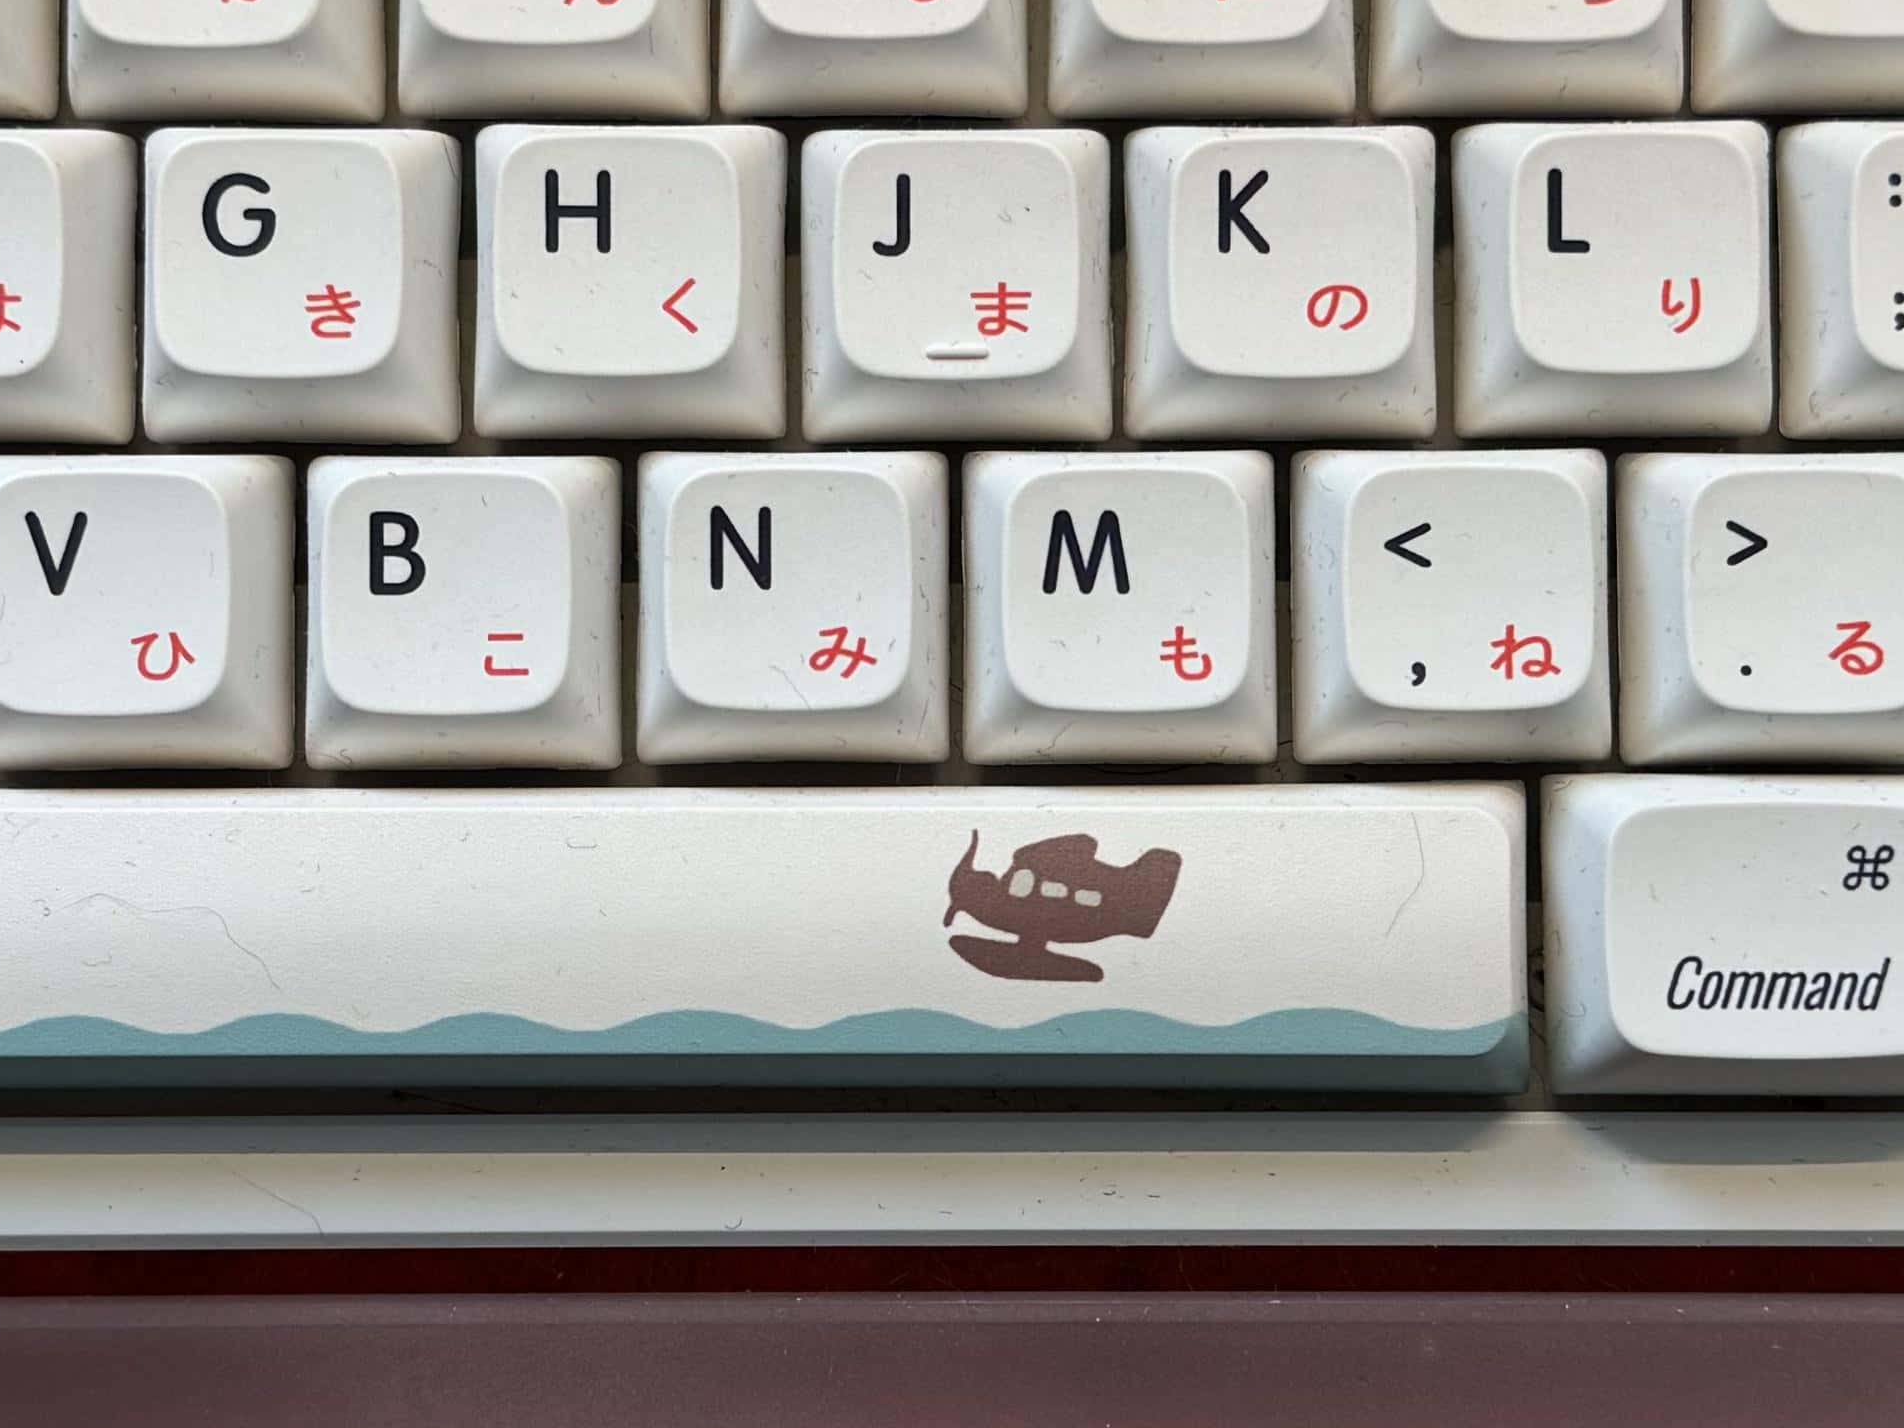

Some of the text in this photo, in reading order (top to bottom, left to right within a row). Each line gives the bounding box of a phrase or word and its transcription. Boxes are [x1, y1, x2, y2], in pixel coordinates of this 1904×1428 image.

[200, 171, 278, 259] G
[543, 167, 613, 255] H
[871, 172, 912, 258] J
[1216, 167, 1272, 256] K
[1545, 166, 1592, 255] L
[1887, 171, 1904, 209] :
[303, 282, 360, 341] き
[661, 276, 699, 334] く
[970, 281, 1032, 338] ま
[1305, 282, 1370, 333] の
[1659, 276, 1704, 335] り
[23, 509, 89, 598] V
[367, 509, 428, 597] B
[708, 504, 773, 592] N
[1041, 508, 1132, 596] M
[1382, 521, 1434, 569] <
[1724, 519, 1770, 568] >
[128, 630, 195, 683] ひ
[482, 630, 530, 678] こ
[807, 625, 878, 680] み
[1159, 624, 1214, 683] も
[1410, 623, 1562, 688] , ね
[1739, 619, 1886, 678] . る
[1665, 954, 1893, 1013] Command
